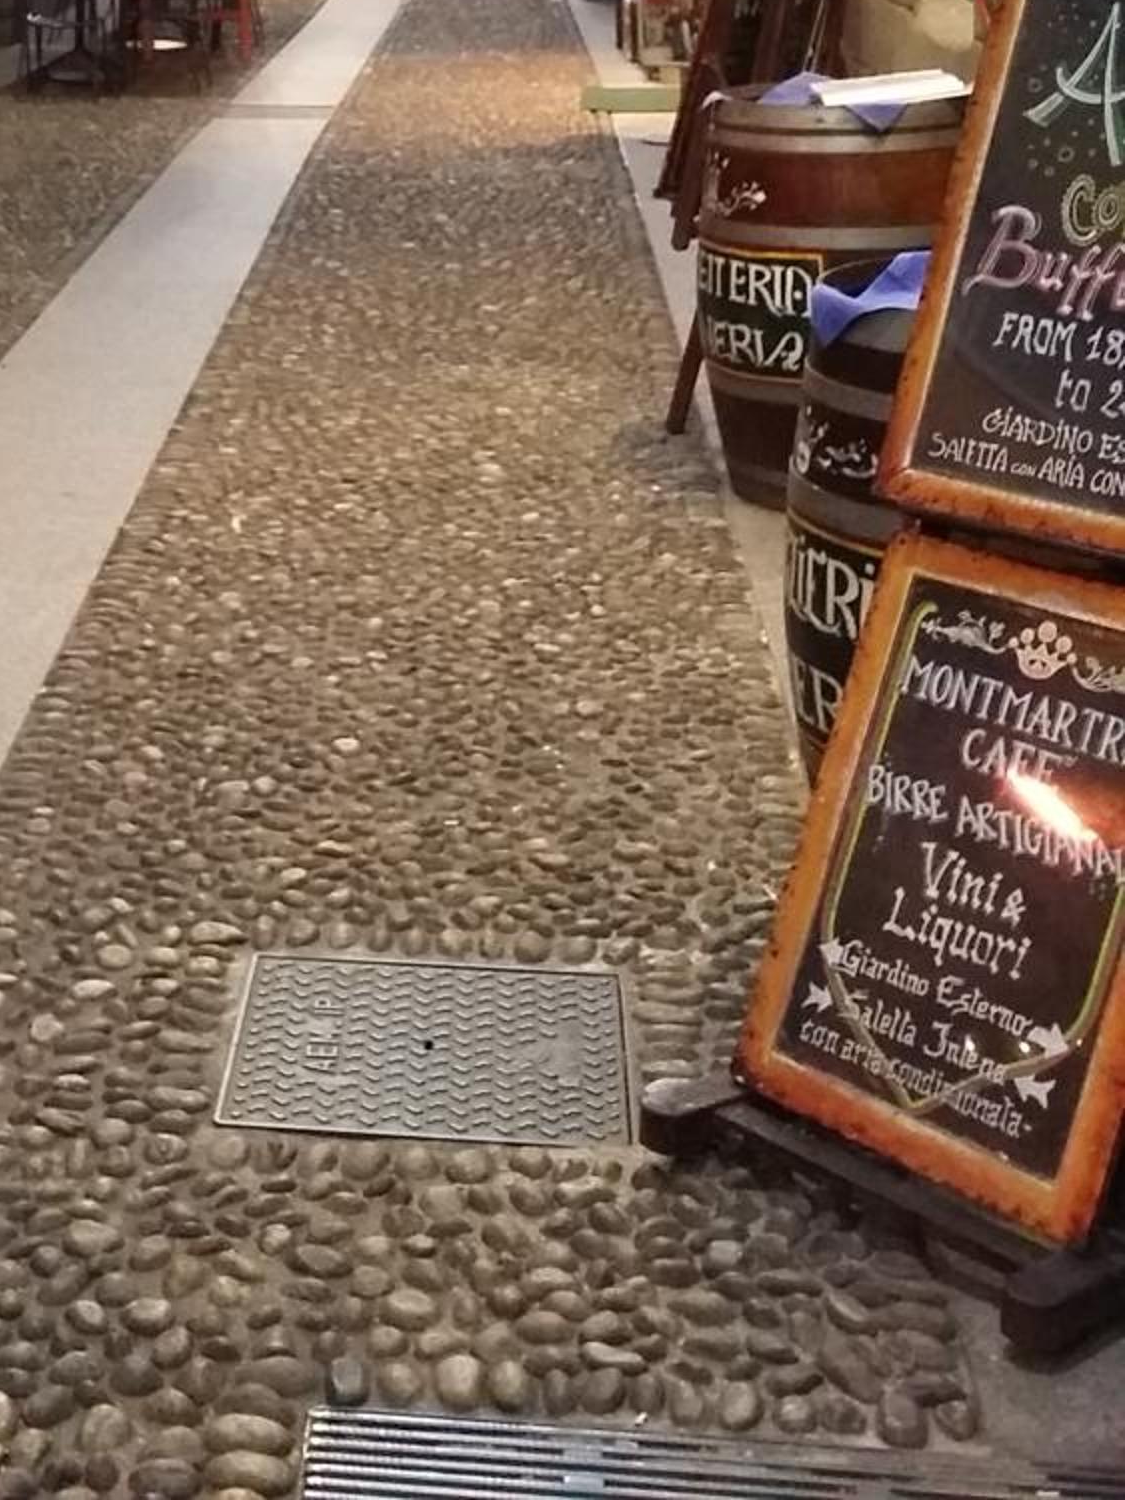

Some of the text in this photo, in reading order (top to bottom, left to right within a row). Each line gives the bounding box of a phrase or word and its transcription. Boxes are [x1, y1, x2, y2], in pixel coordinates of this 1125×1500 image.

[992, 311, 1078, 362] FROM
[1037, 454, 1086, 490] ARIA
[899, 654, 1125, 766] MONTMARTR
[866, 764, 949, 823] BIRRE
[920, 841, 1004, 915] Vini
[882, 886, 1033, 980] Liquori
[841, 939, 1034, 1037] Giardino Esterno
